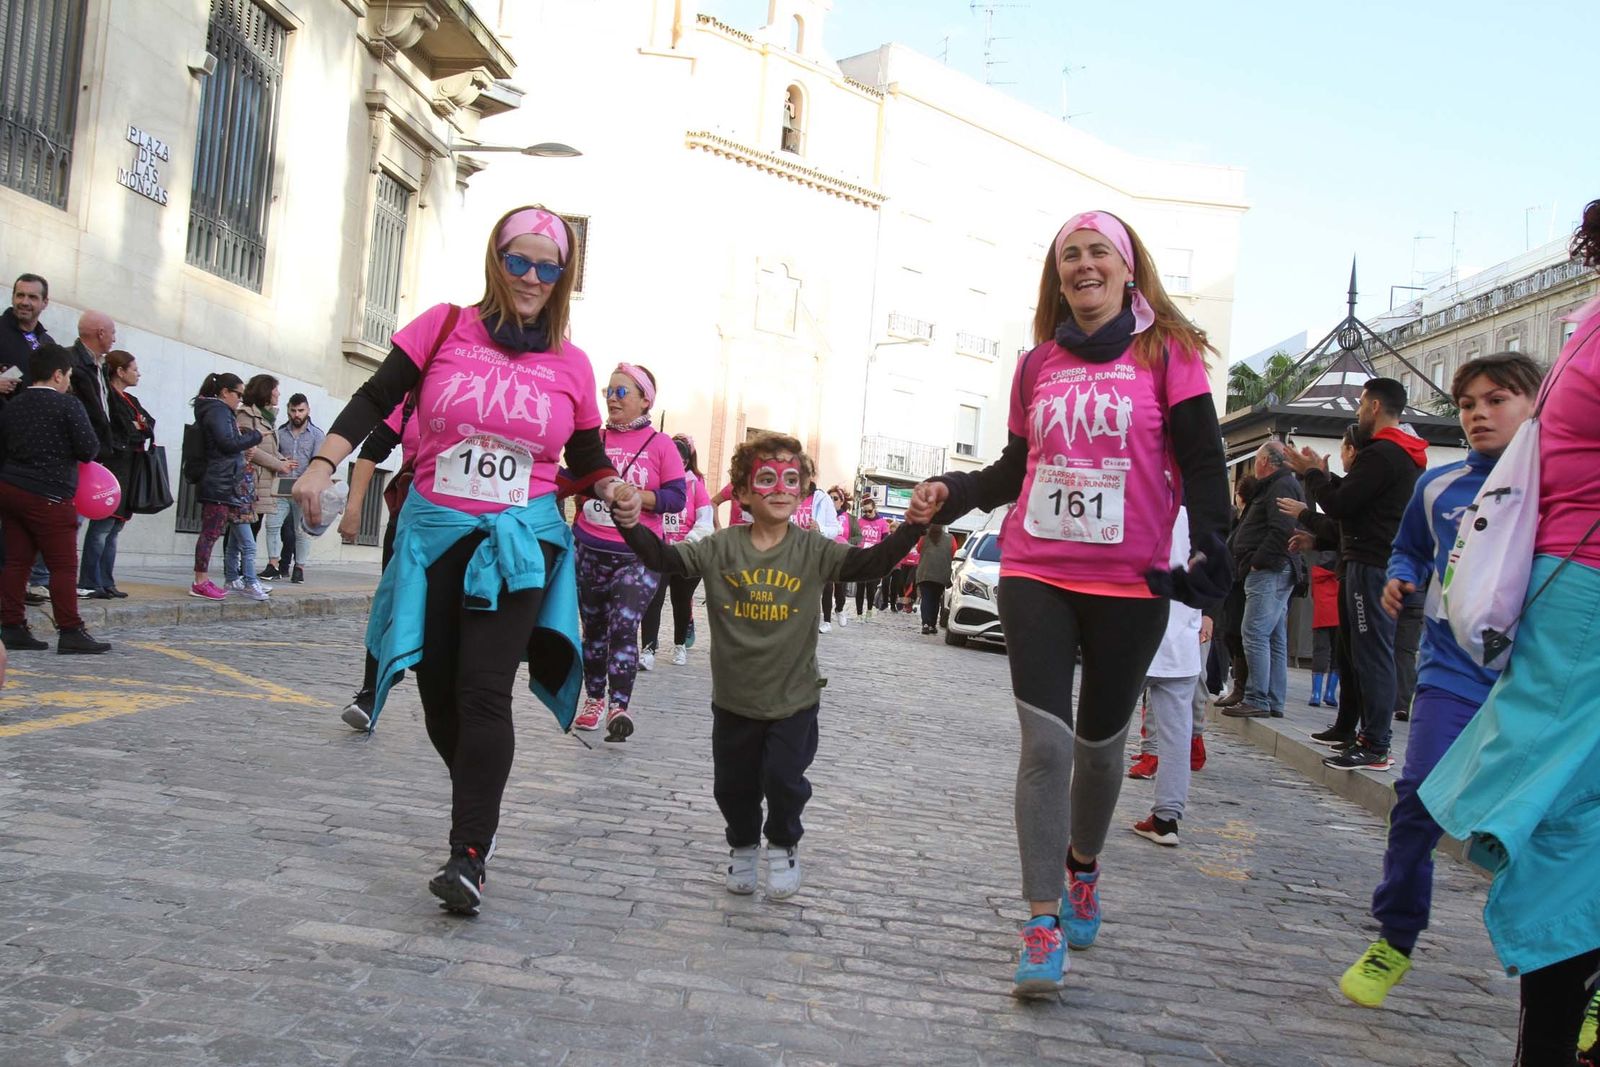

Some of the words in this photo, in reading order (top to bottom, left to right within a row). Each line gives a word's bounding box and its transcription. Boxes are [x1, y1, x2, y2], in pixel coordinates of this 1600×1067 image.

[129, 126, 169, 161] PLAZA
[140, 148, 155, 168] DE
[135, 160, 158, 184] LAS
[119, 168, 168, 205] MONJAS
[455, 347, 466, 357] DE
[467, 351, 477, 360] LA
[479, 354, 508, 367] MUJER
[1051, 367, 1087, 380] CARRERA
[1114, 364, 1136, 374] PINK
[1094, 371, 1137, 381] RUNNING
[459, 448, 517, 482] 160
[1048, 488, 1104, 520] 161
[750, 590, 773, 602] PARA
[734, 600, 789, 620] LUCHAR
